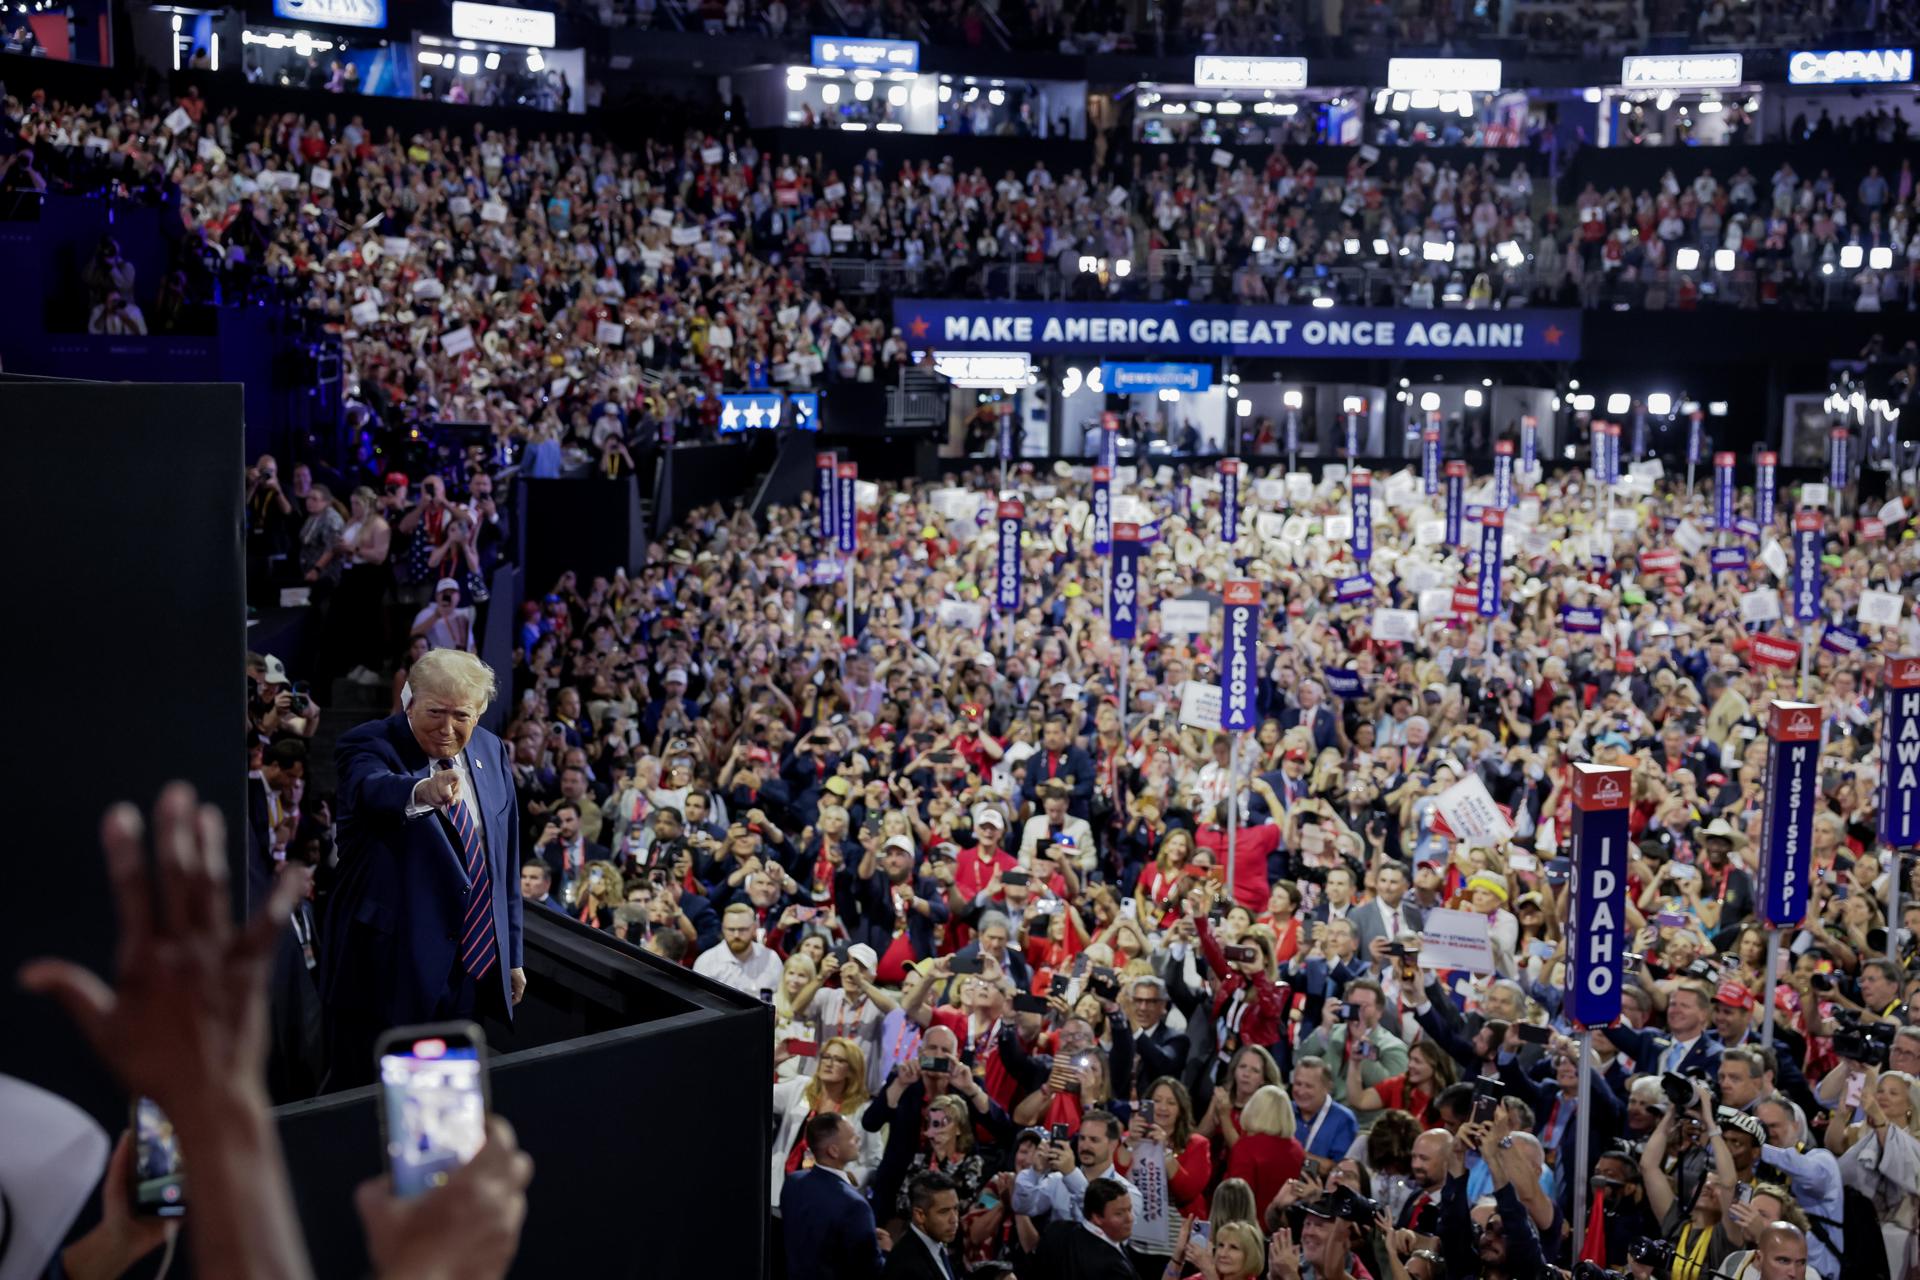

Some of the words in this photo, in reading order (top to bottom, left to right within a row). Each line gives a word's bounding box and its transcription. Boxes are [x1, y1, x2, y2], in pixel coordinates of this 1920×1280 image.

[1789, 50, 1912, 83] C-SPAN
[945, 317, 1033, 343] MAKE
[1043, 317, 1180, 344] AMERICA
[1189, 319, 1292, 345] GREAT
[1302, 321, 1395, 346] ONCE
[1404, 322, 1524, 348] AGAIN!
[1095, 488, 1108, 544] GUAM
[1354, 493, 1369, 550] MAINE
[1001, 519, 1018, 604] OREGON
[1113, 555, 1136, 622] IOWA
[1480, 527, 1498, 612] INDIANA
[1799, 532, 1815, 617] FLORIDA
[1229, 606, 1250, 725] OKLAHOMA
[1896, 693, 1920, 838] HAWAII
[1783, 747, 1807, 917] MISSISSIPPI
[1566, 834, 1578, 991] IDAHO
[1587, 837, 1616, 996] IDAHO
[1140, 1158, 1150, 1222] AMERICA
